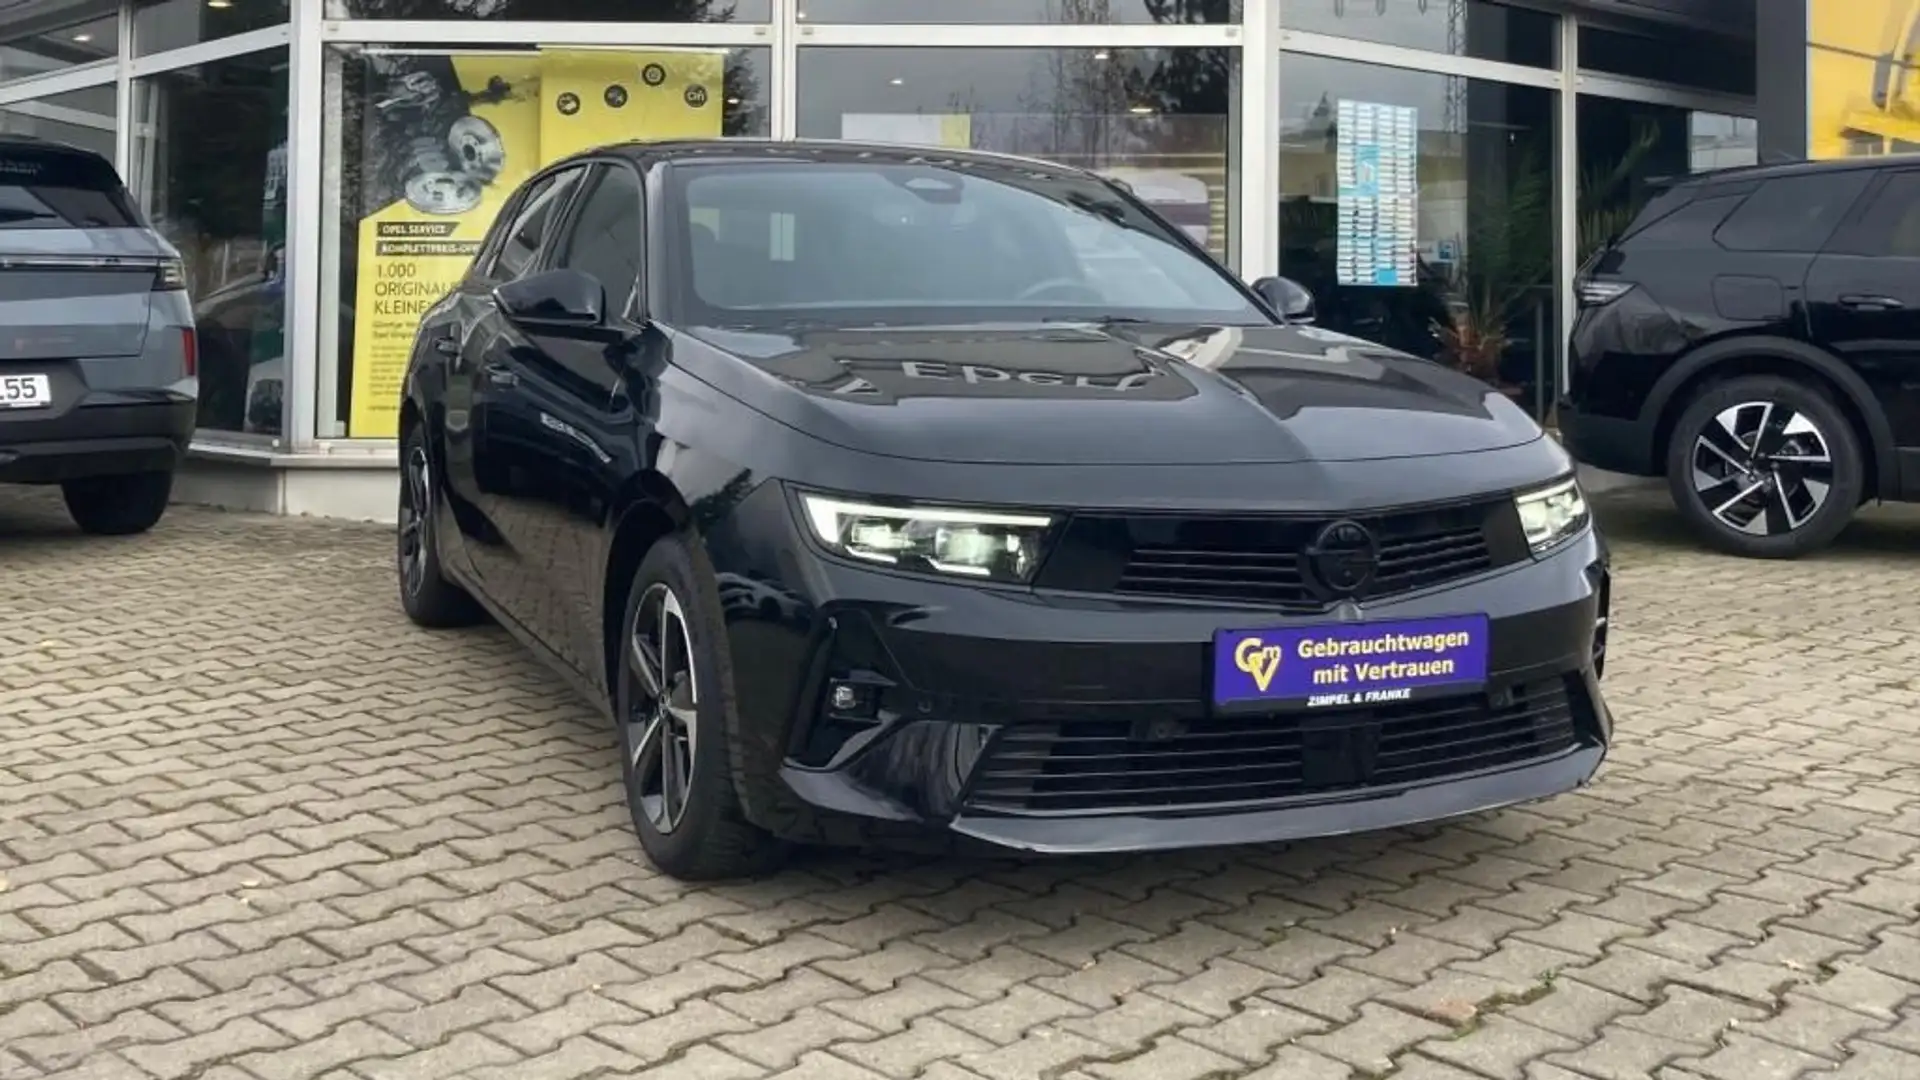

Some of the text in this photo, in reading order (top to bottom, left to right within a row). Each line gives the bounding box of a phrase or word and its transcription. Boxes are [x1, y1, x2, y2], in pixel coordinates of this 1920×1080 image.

[382, 224, 447, 235] OPEL SERVICE
[377, 261, 417, 278] 1.000
[1297, 630, 1470, 659] Gebrauchtwagen
[1313, 659, 1454, 685] mit Vertrauen
[1306, 688, 1412, 707] ZIMPEL & FRANKE
